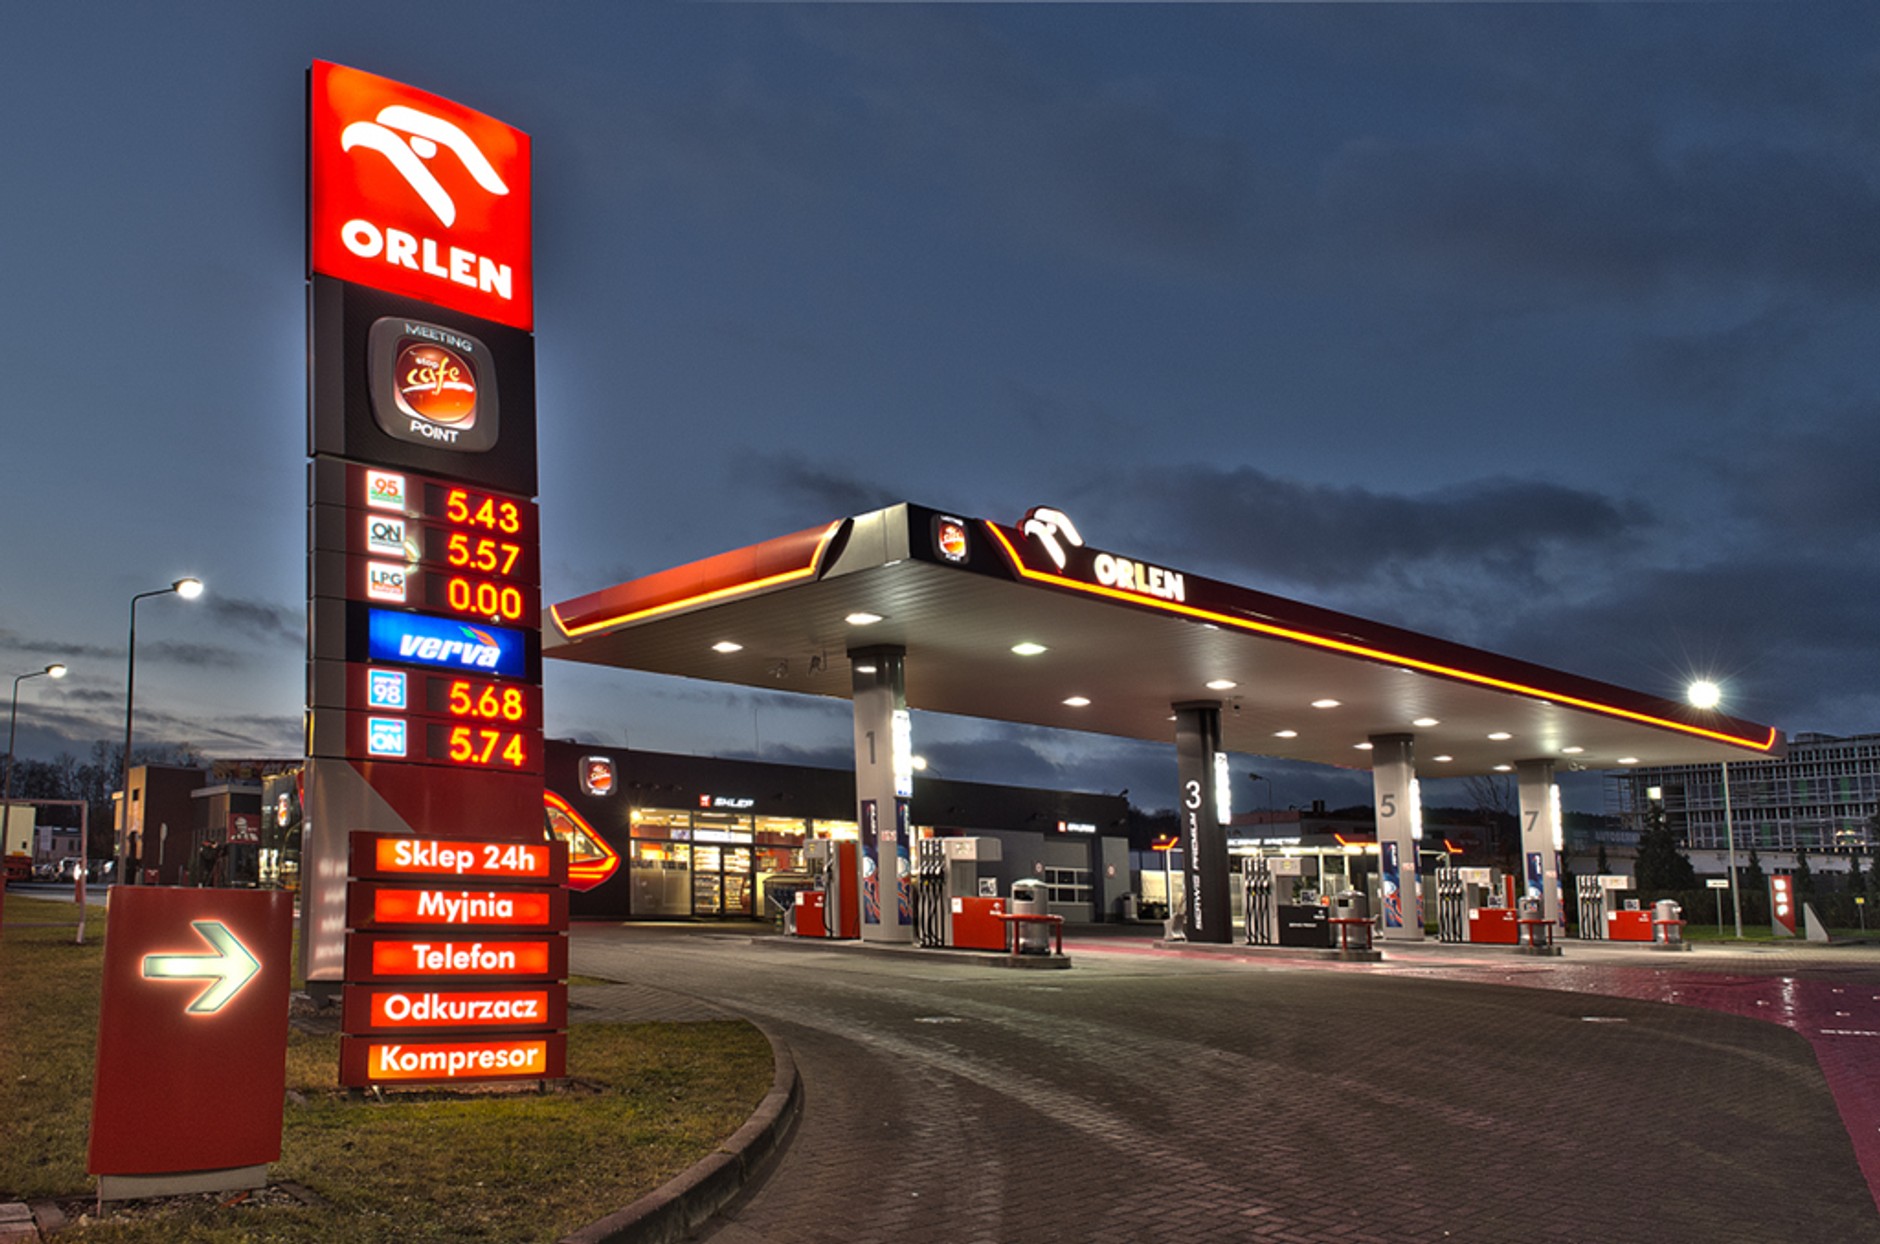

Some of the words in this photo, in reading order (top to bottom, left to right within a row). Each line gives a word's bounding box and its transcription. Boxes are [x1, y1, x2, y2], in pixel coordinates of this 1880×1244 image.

[341, 219, 512, 300] ORLEN
[404, 323, 473, 352] MEETING
[406, 357, 461, 395] cafe
[409, 421, 459, 443] POINT
[375, 478, 398, 497] 95
[448, 490, 519, 533] 5.43
[372, 522, 402, 542] ON
[448, 534, 520, 575] 5.57
[371, 570, 403, 586] LPG
[1094, 553, 1185, 602] ORLEN
[449, 578, 521, 619] 0.00
[399, 634, 501, 668] verva
[373, 684, 402, 704] 98
[450, 681, 523, 721] 5.68
[371, 733, 402, 751] ON
[450, 727, 524, 766] 5.74
[865, 730, 876, 764] 1
[1185, 780, 1201, 809] 3
[1380, 794, 1396, 818] 5
[1524, 811, 1539, 832] 7
[394, 841, 474, 874] Sklep
[483, 845, 535, 870] 24h
[417, 891, 513, 923] Myjnia
[412, 943, 515, 969] Telefon
[384, 994, 538, 1020] Odkurzacz
[380, 1046, 538, 1076] Kompresor
